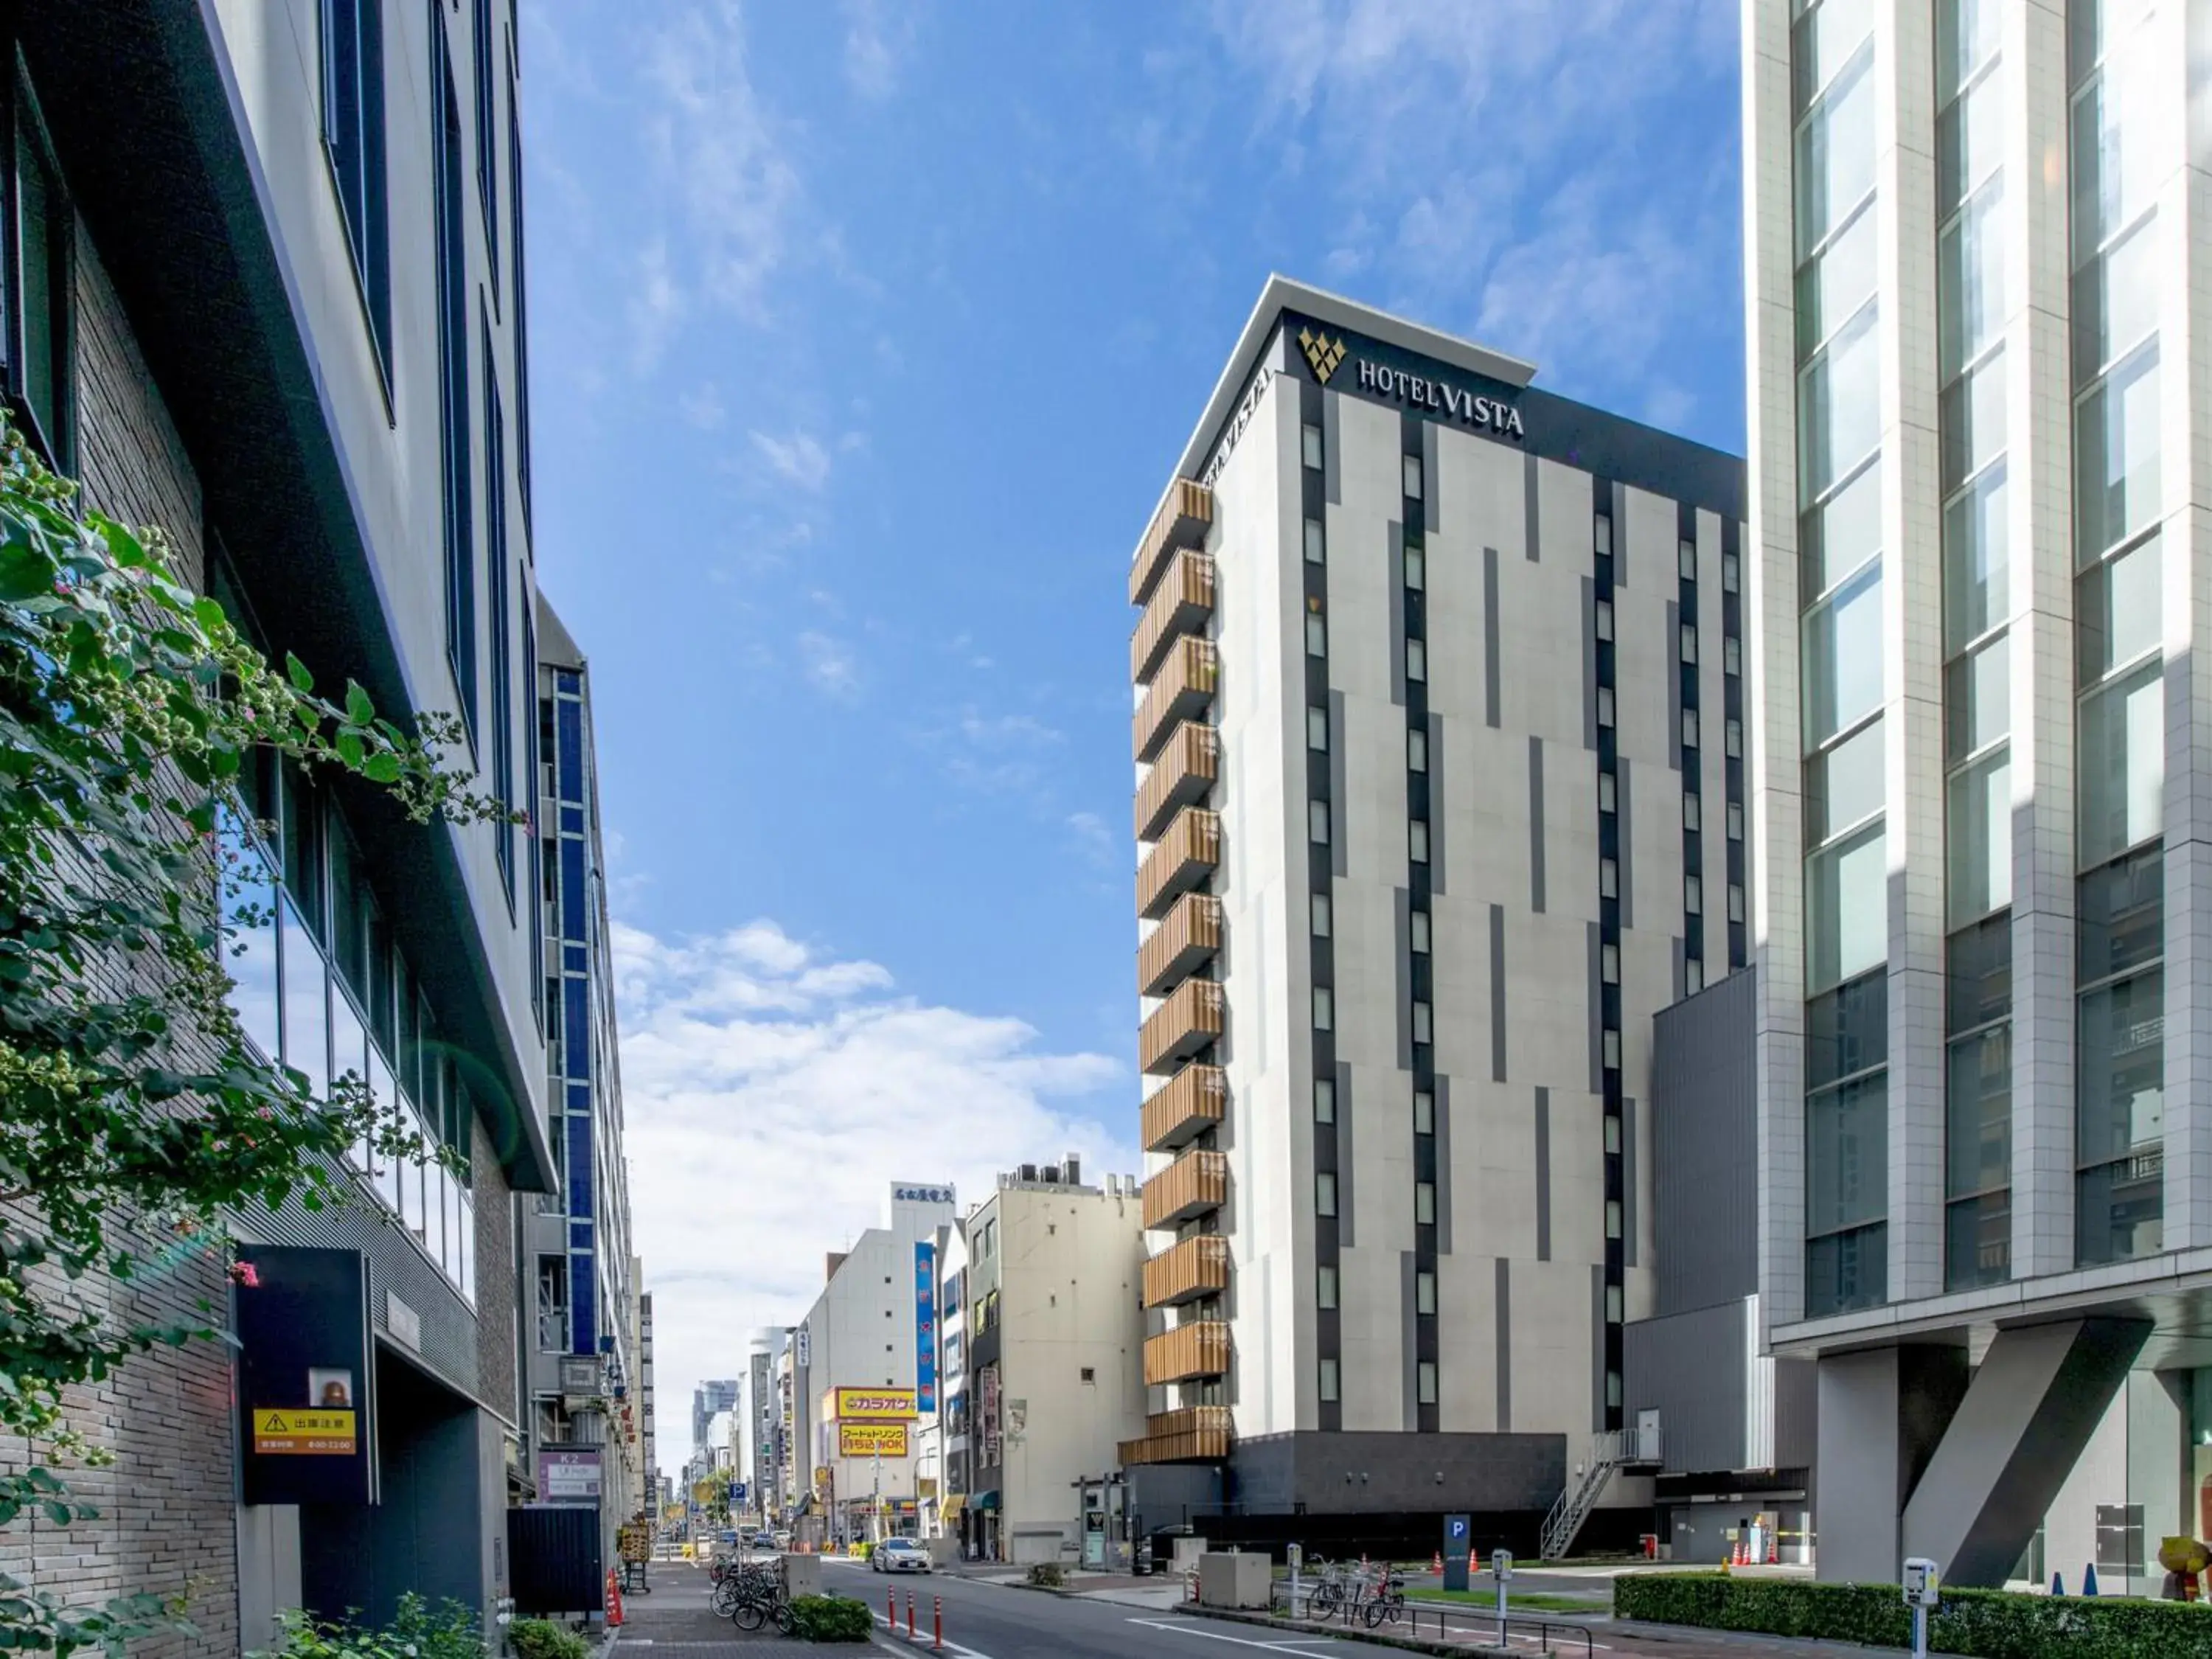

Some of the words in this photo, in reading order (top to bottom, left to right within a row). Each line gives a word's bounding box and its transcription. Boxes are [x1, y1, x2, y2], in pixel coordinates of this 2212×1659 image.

[1359, 358, 1439, 408] HOTEL
[1439, 382, 1525, 436] VISTA
[856, 1397, 909, 1410] カラオケ
[733, 1485, 743, 1498] P
[1453, 1521, 1464, 1537] P
